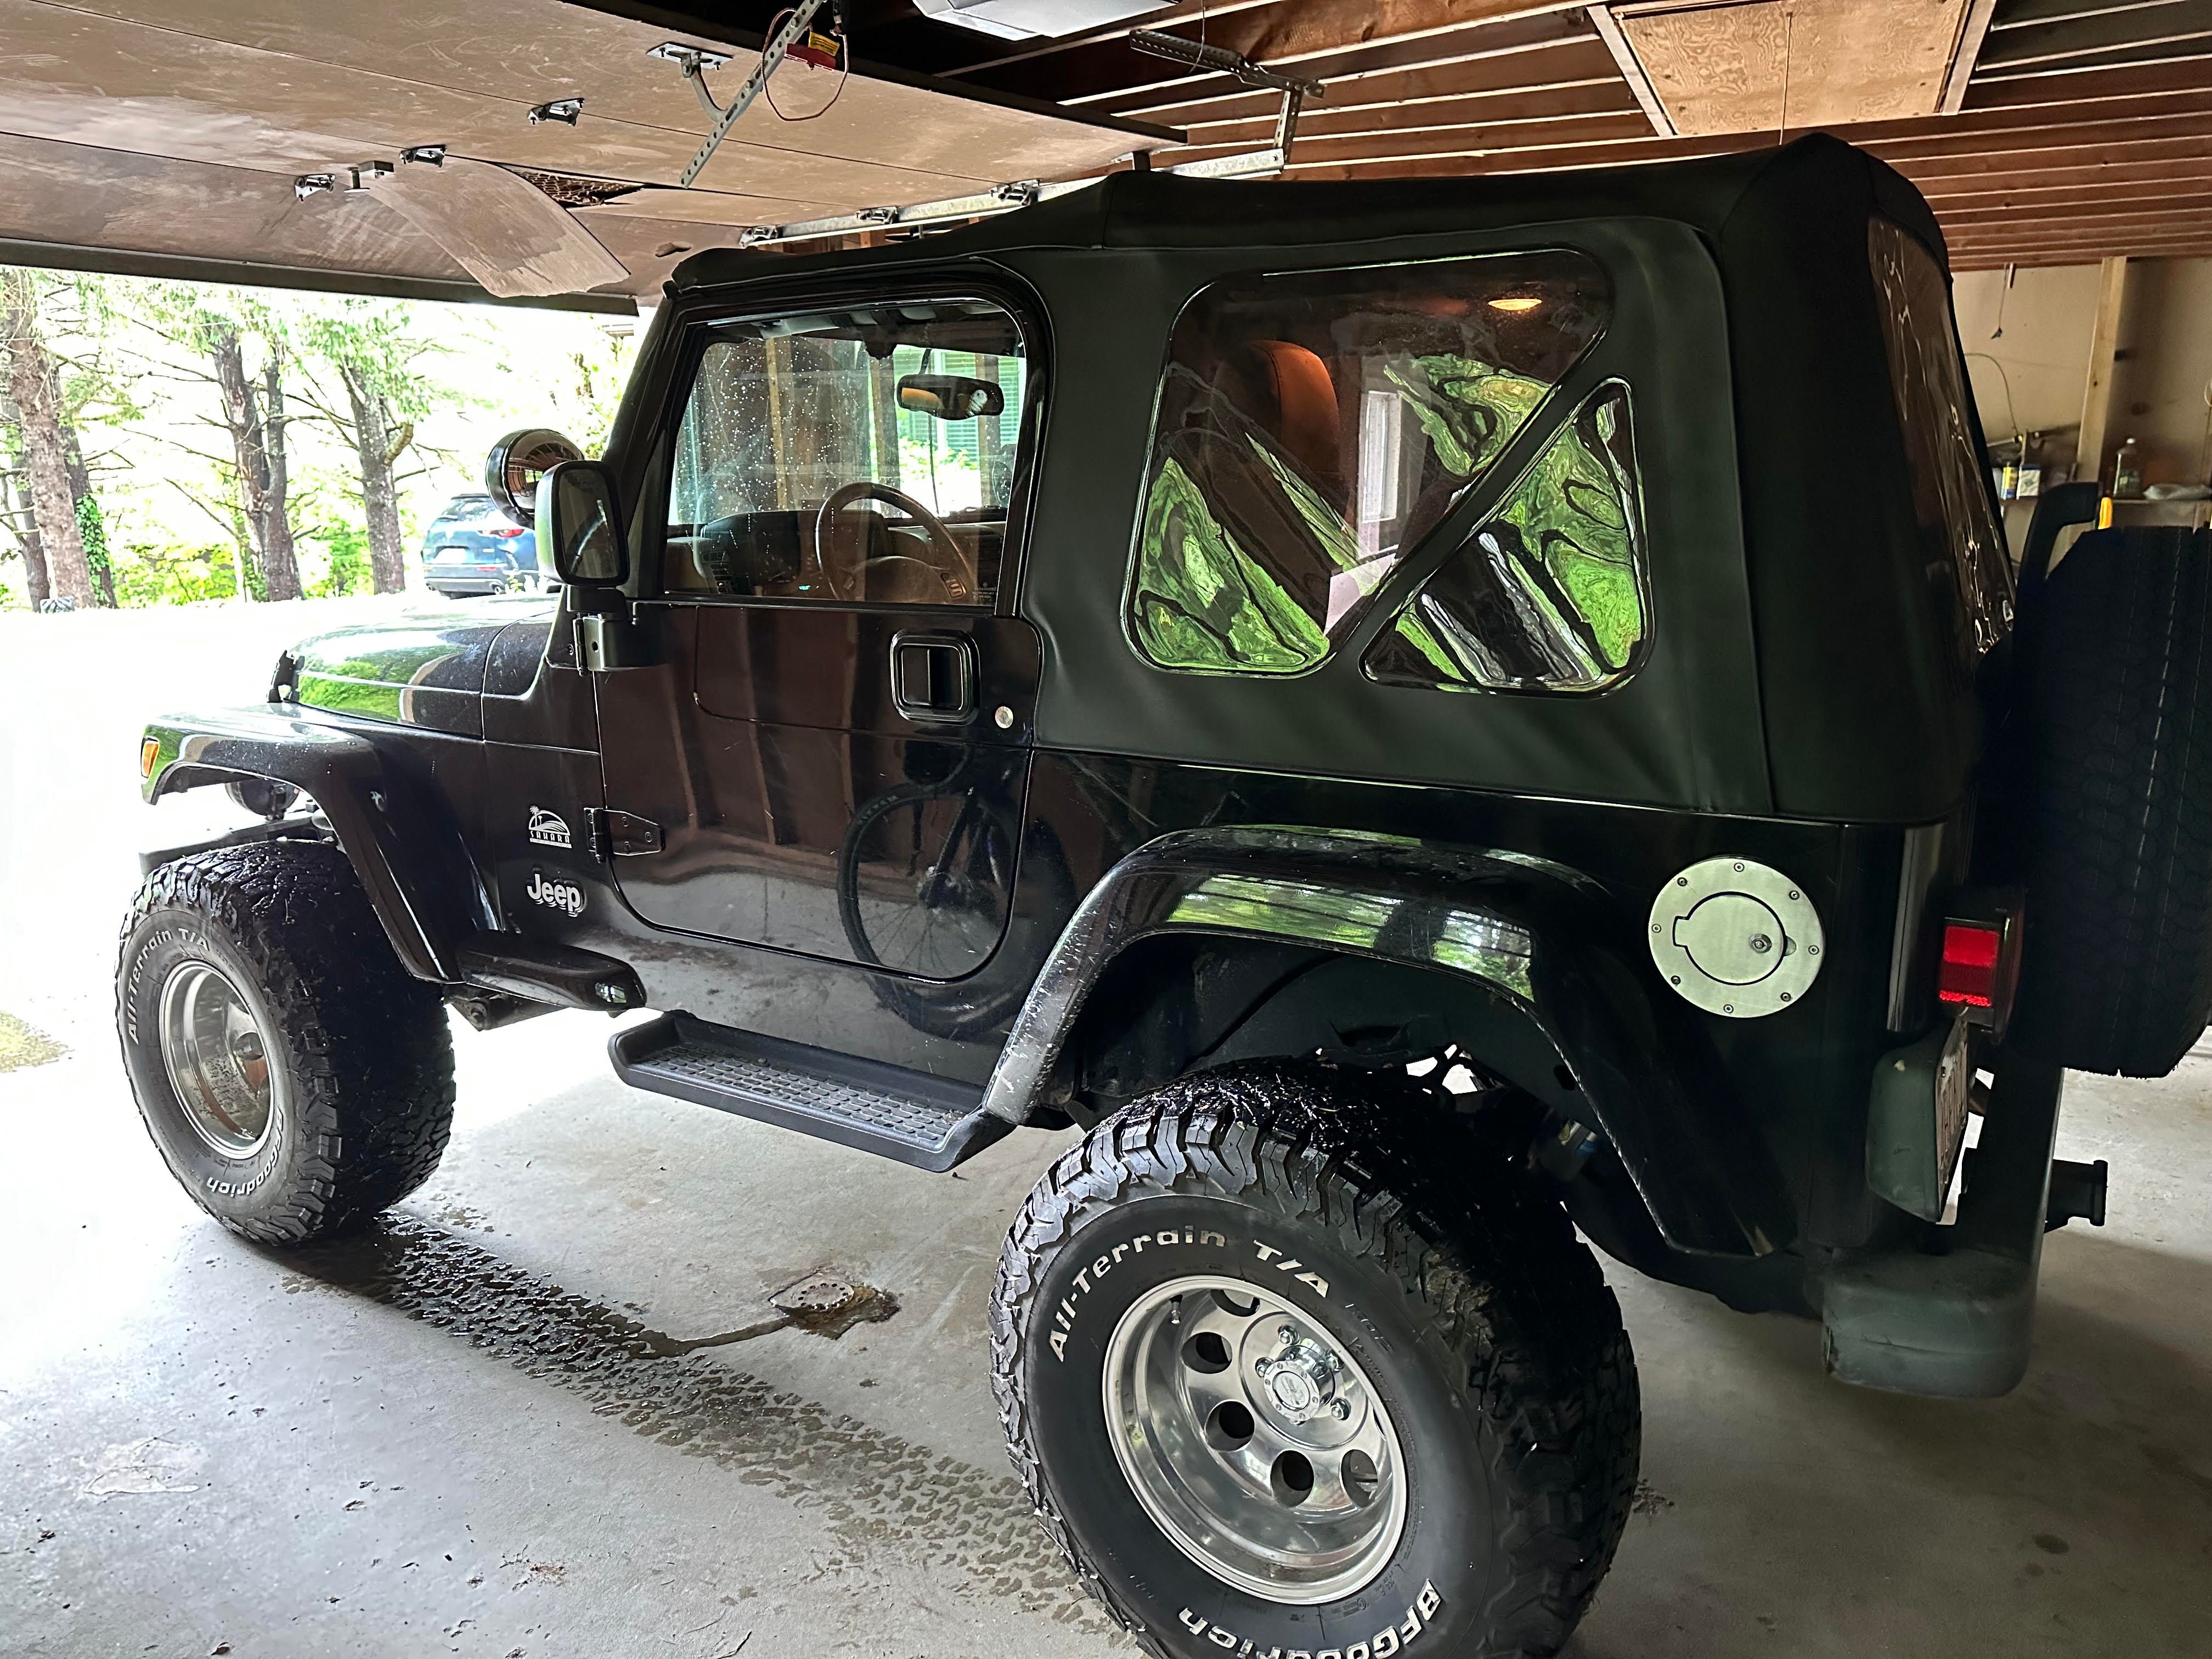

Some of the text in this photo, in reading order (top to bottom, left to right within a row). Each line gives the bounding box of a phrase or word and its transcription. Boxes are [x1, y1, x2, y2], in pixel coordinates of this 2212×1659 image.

[530, 830, 570, 843] SAHARA
[527, 873, 580, 912] Jeep
[127, 929, 173, 1045] All-Terrain
[178, 928, 210, 951] T/A
[206, 1106, 284, 1197] BFGoodrich
[1049, 1225, 1226, 1362] All-Terrain
[1254, 1240, 1329, 1298] T/A
